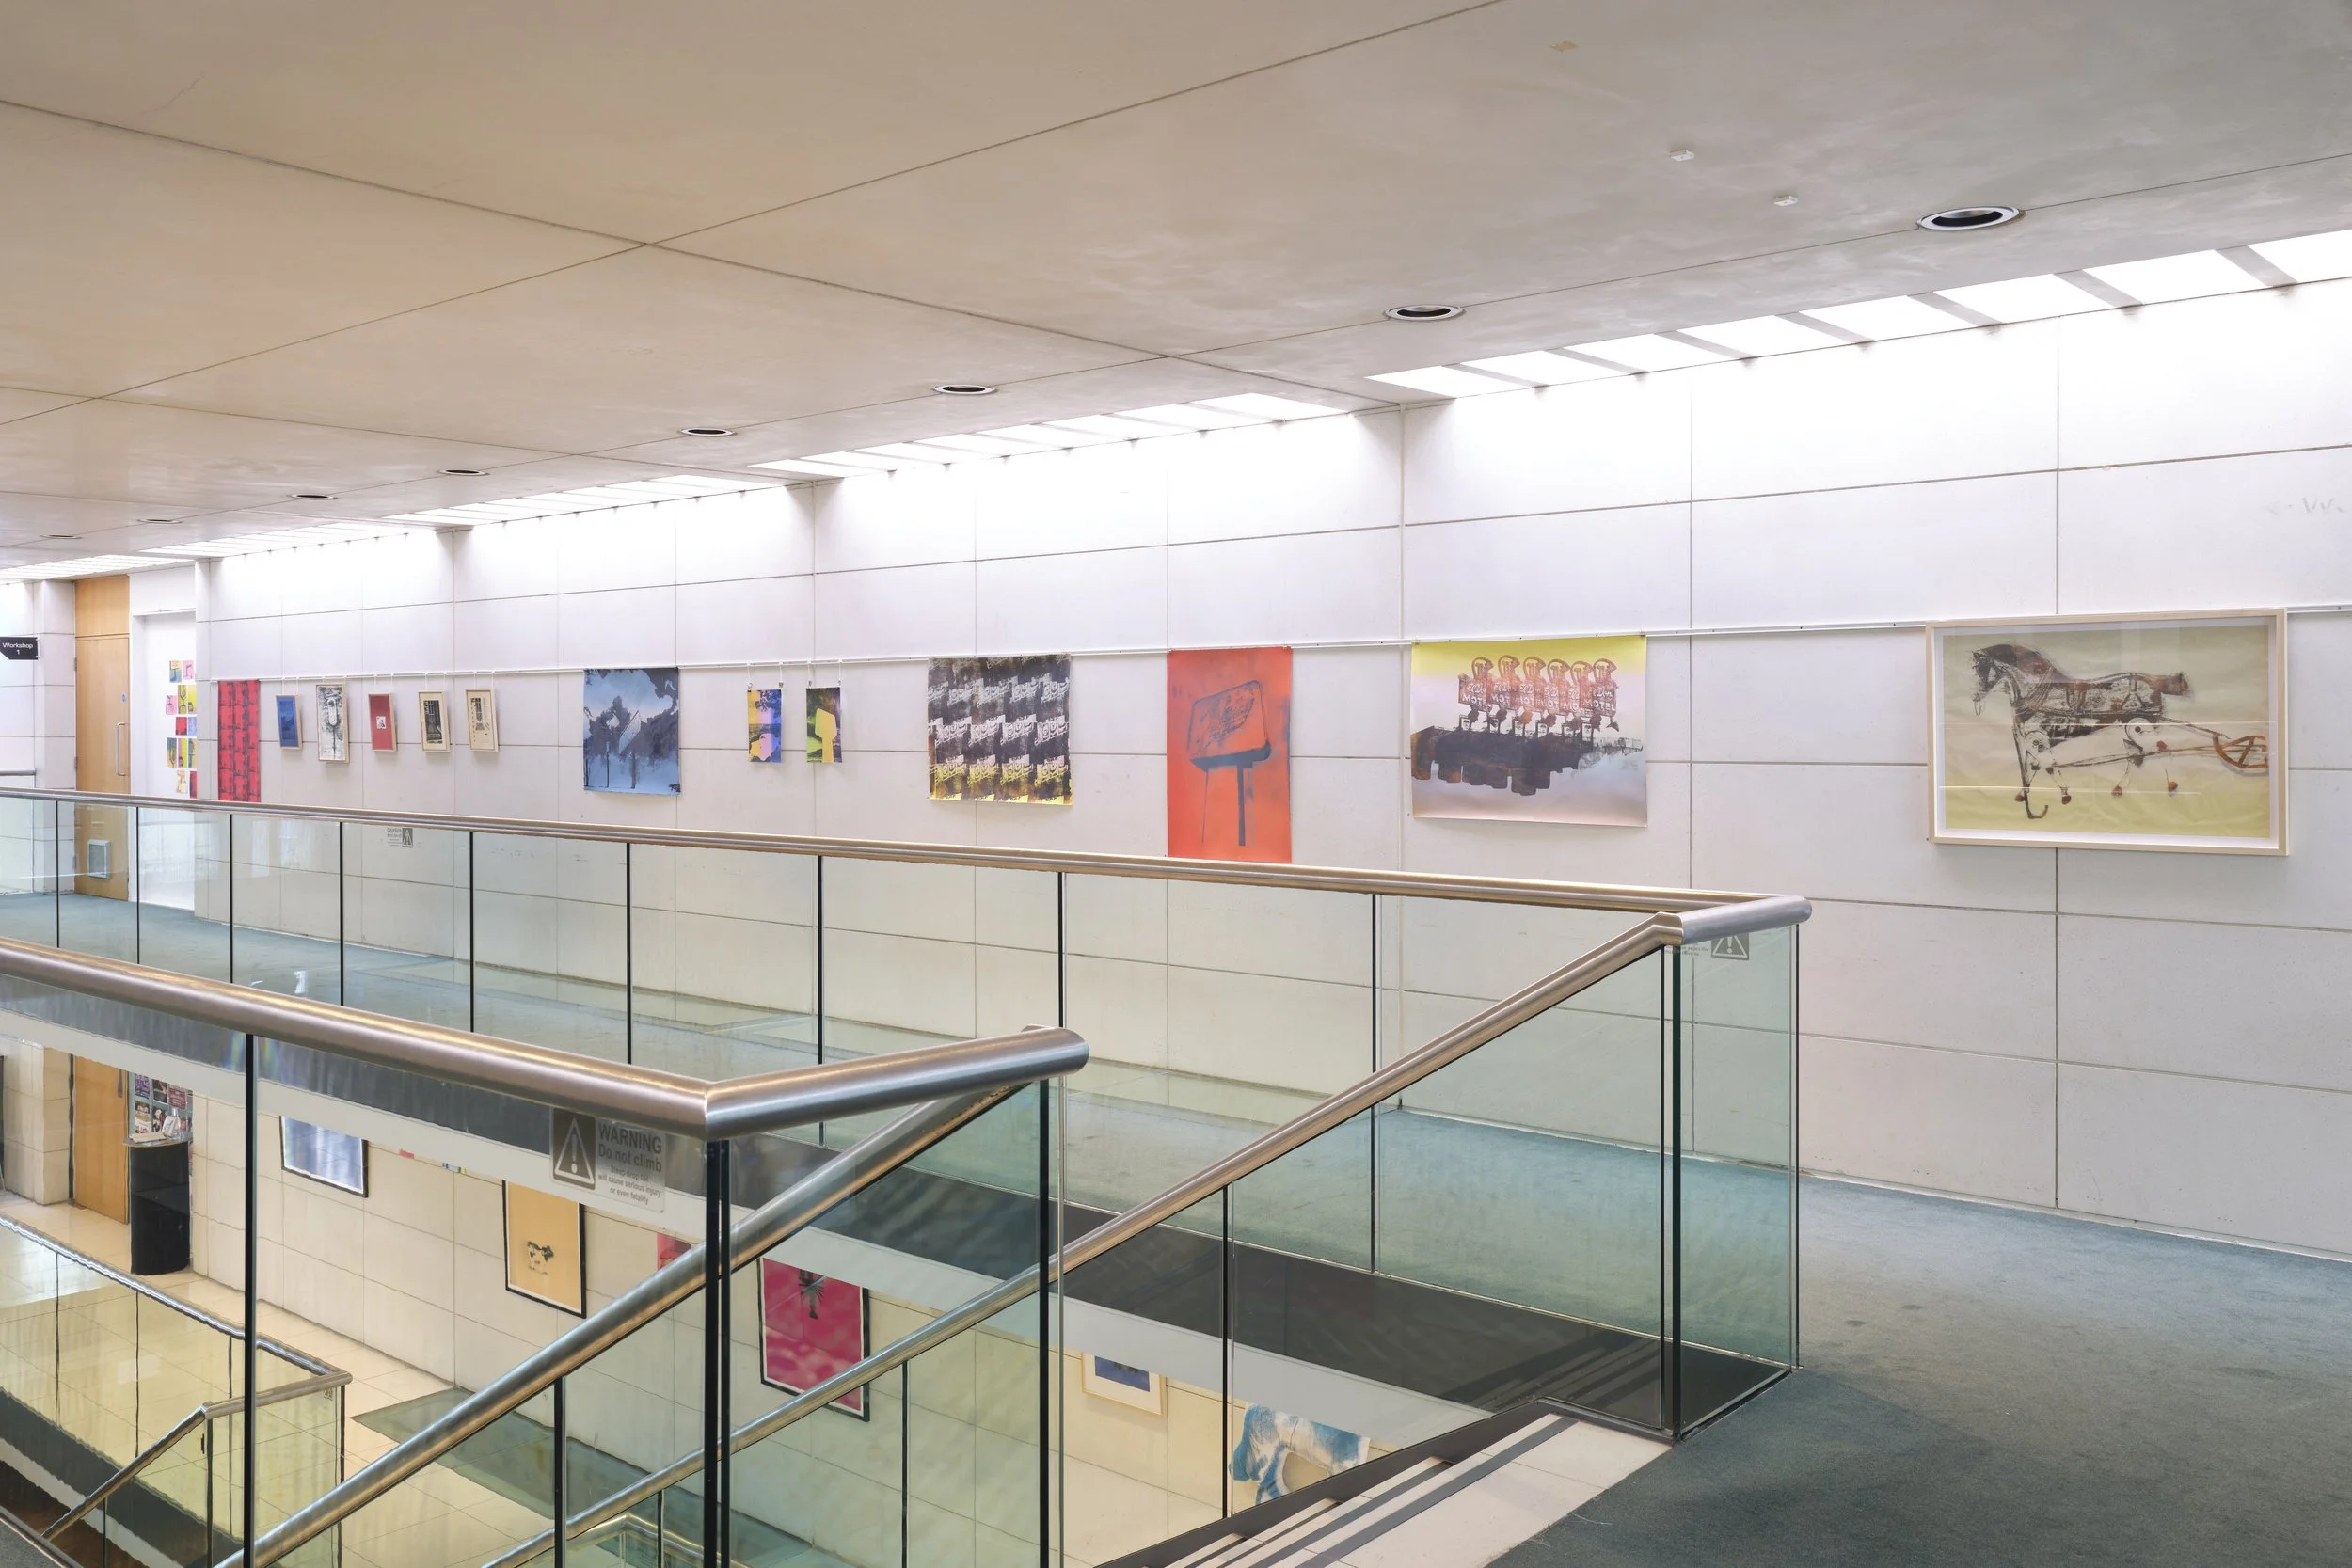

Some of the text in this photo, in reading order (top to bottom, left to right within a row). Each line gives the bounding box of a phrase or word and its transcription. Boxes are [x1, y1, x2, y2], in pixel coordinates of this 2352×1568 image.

[597, 1122, 662, 1155] WARNING
[598, 1143, 662, 1172] Do not climb
[608, 1176, 624, 1186] cause
[625, 1180, 644, 1192] serious
[616, 1189, 629, 1197] even
[630, 1191, 649, 1205] fatality
